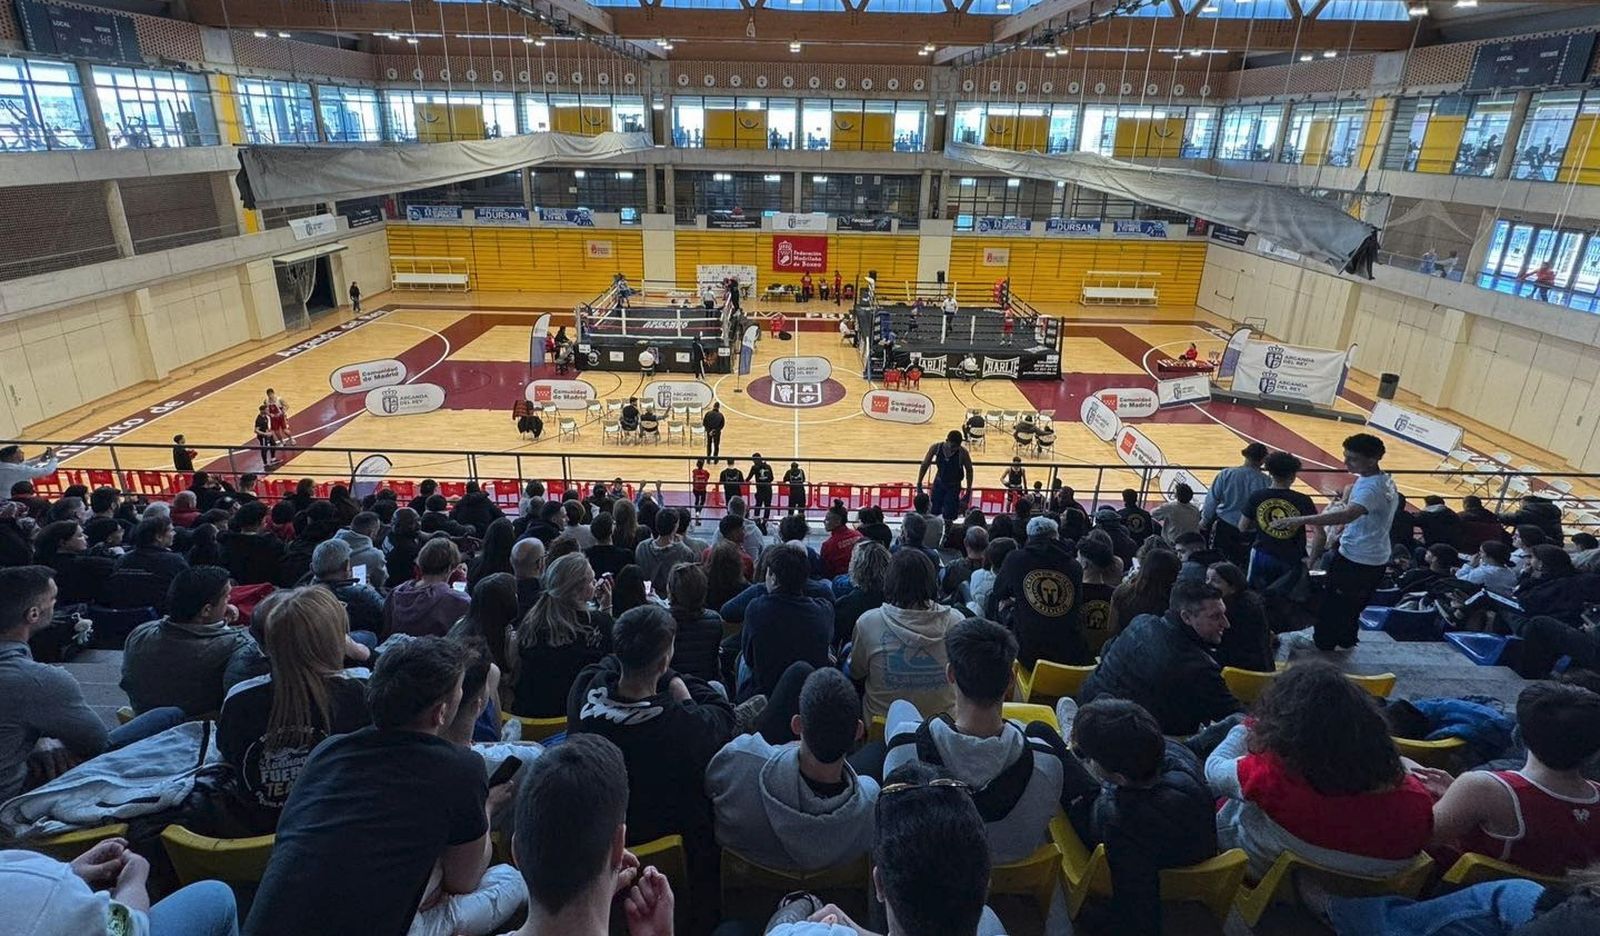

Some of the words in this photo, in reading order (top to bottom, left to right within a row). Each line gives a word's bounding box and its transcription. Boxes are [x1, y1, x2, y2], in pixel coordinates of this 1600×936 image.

[485, 211, 522, 221] DURSAN
[1057, 222, 1095, 233] DURSAN
[361, 366, 399, 377] Comunidad
[982, 356, 1020, 378] CHARLIE
[373, 371, 400, 380] Madrid
[552, 388, 588, 396] Comunidad
[148, 399, 185, 414] de
[890, 400, 926, 409] Comunidad
[900, 406, 926, 415] Madrid
